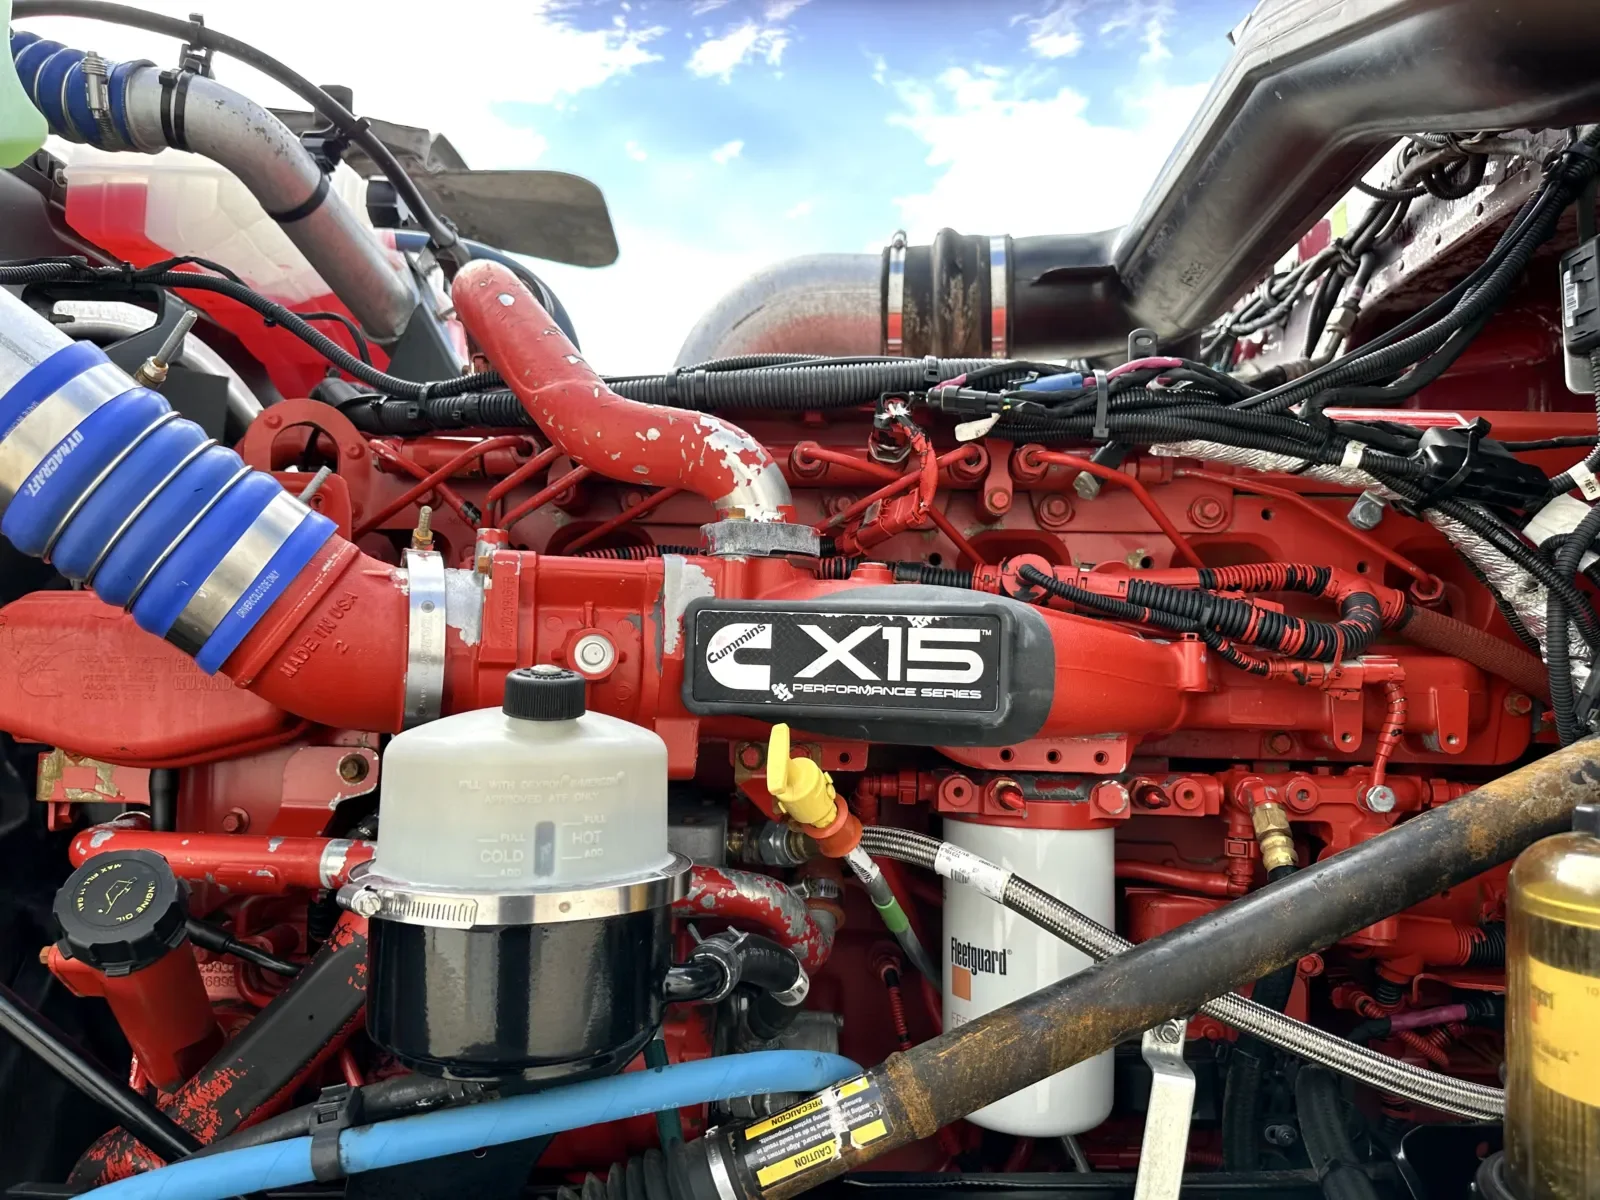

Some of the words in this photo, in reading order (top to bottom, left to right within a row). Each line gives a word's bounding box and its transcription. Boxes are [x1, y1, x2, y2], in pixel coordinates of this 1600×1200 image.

[27, 430, 84, 497] DYNACRAFT
[267, 569, 280, 583] ONLY
[279, 636, 320, 679] MADE
[314, 616, 337, 639] IN
[328, 590, 359, 620] USA
[334, 639, 349, 655] 2
[707, 624, 766, 664] Cummins
[793, 684, 916, 697] PERFORMANCE
[920, 688, 982, 700] SERIES
[484, 793, 541, 804] APPROVED
[548, 793, 569, 803] ATF
[574, 791, 600, 802] ONLY
[584, 814, 606, 824] FULL
[500, 833, 526, 843] FULL
[572, 831, 603, 845] HOT
[480, 850, 524, 864] COLD
[101, 863, 122, 874] MAX
[83, 872, 99, 886] FILL
[77, 897, 85, 912] GAL
[136, 880, 156, 914] ENGINE
[116, 912, 134, 922] OIL
[951, 937, 1007, 976] Fleetguard
[840, 1095, 863, 1110] damage
[771, 1098, 823, 1126] PRECAUCION
[792, 1117, 812, 1130] system
[758, 1125, 793, 1145] components.
[778, 1134, 795, 1146] could
[794, 1145, 833, 1168] CAUTION
